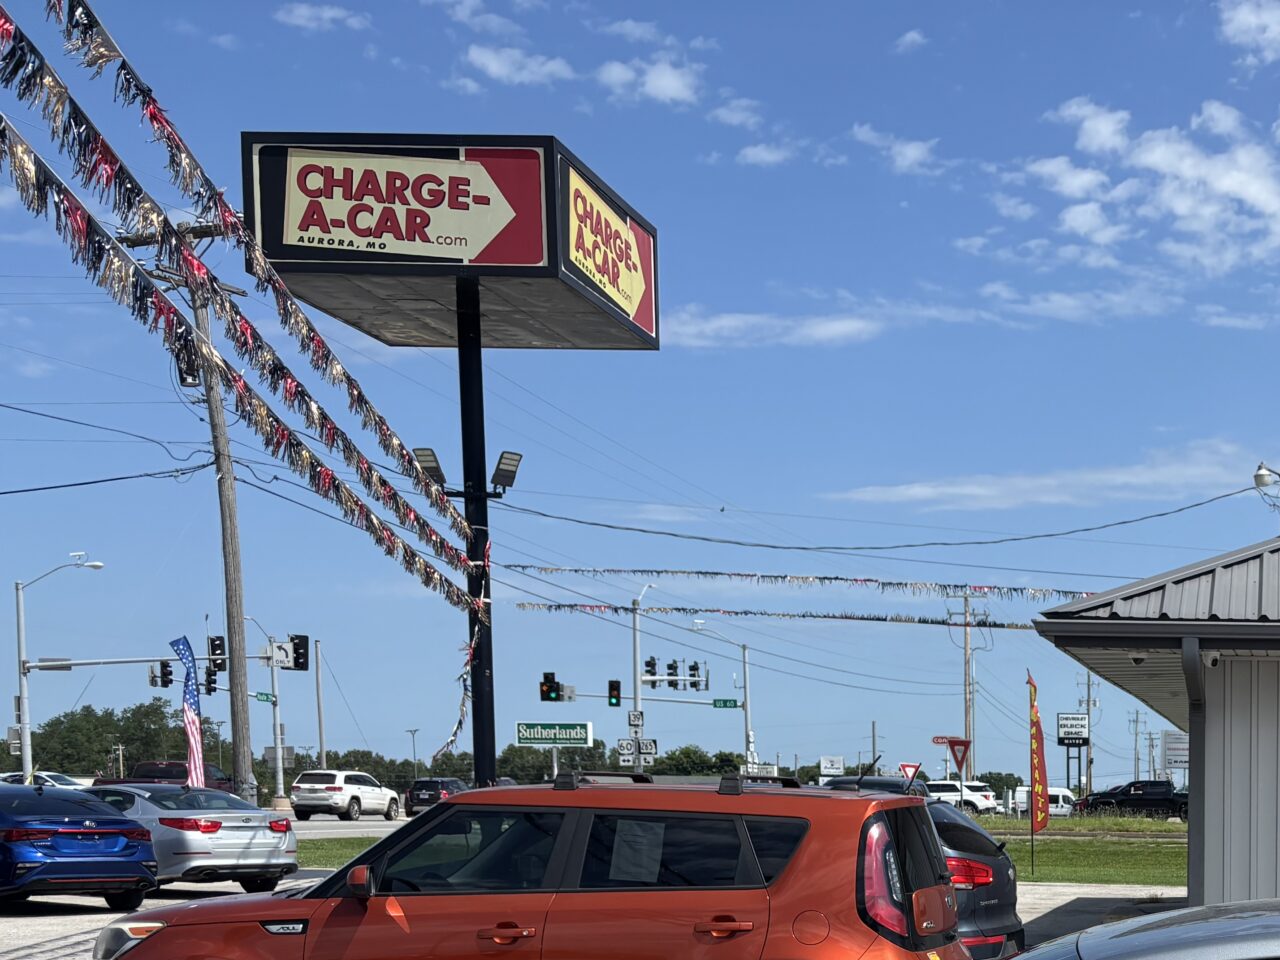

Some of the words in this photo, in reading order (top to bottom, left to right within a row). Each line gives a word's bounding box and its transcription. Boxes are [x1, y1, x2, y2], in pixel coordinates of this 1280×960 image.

[296, 163, 490, 211] CHARGE-
[573, 187, 638, 273] CHARGE-
[297, 235, 361, 250] AURORA,
[366, 240, 387, 250] MO
[715, 700, 724, 708] US
[726, 700, 735, 708] 60
[631, 713, 641, 723] 39
[519, 724, 587, 739] Sutherlands
[619, 741, 633, 752] 60
[640, 741, 654, 751] 265
